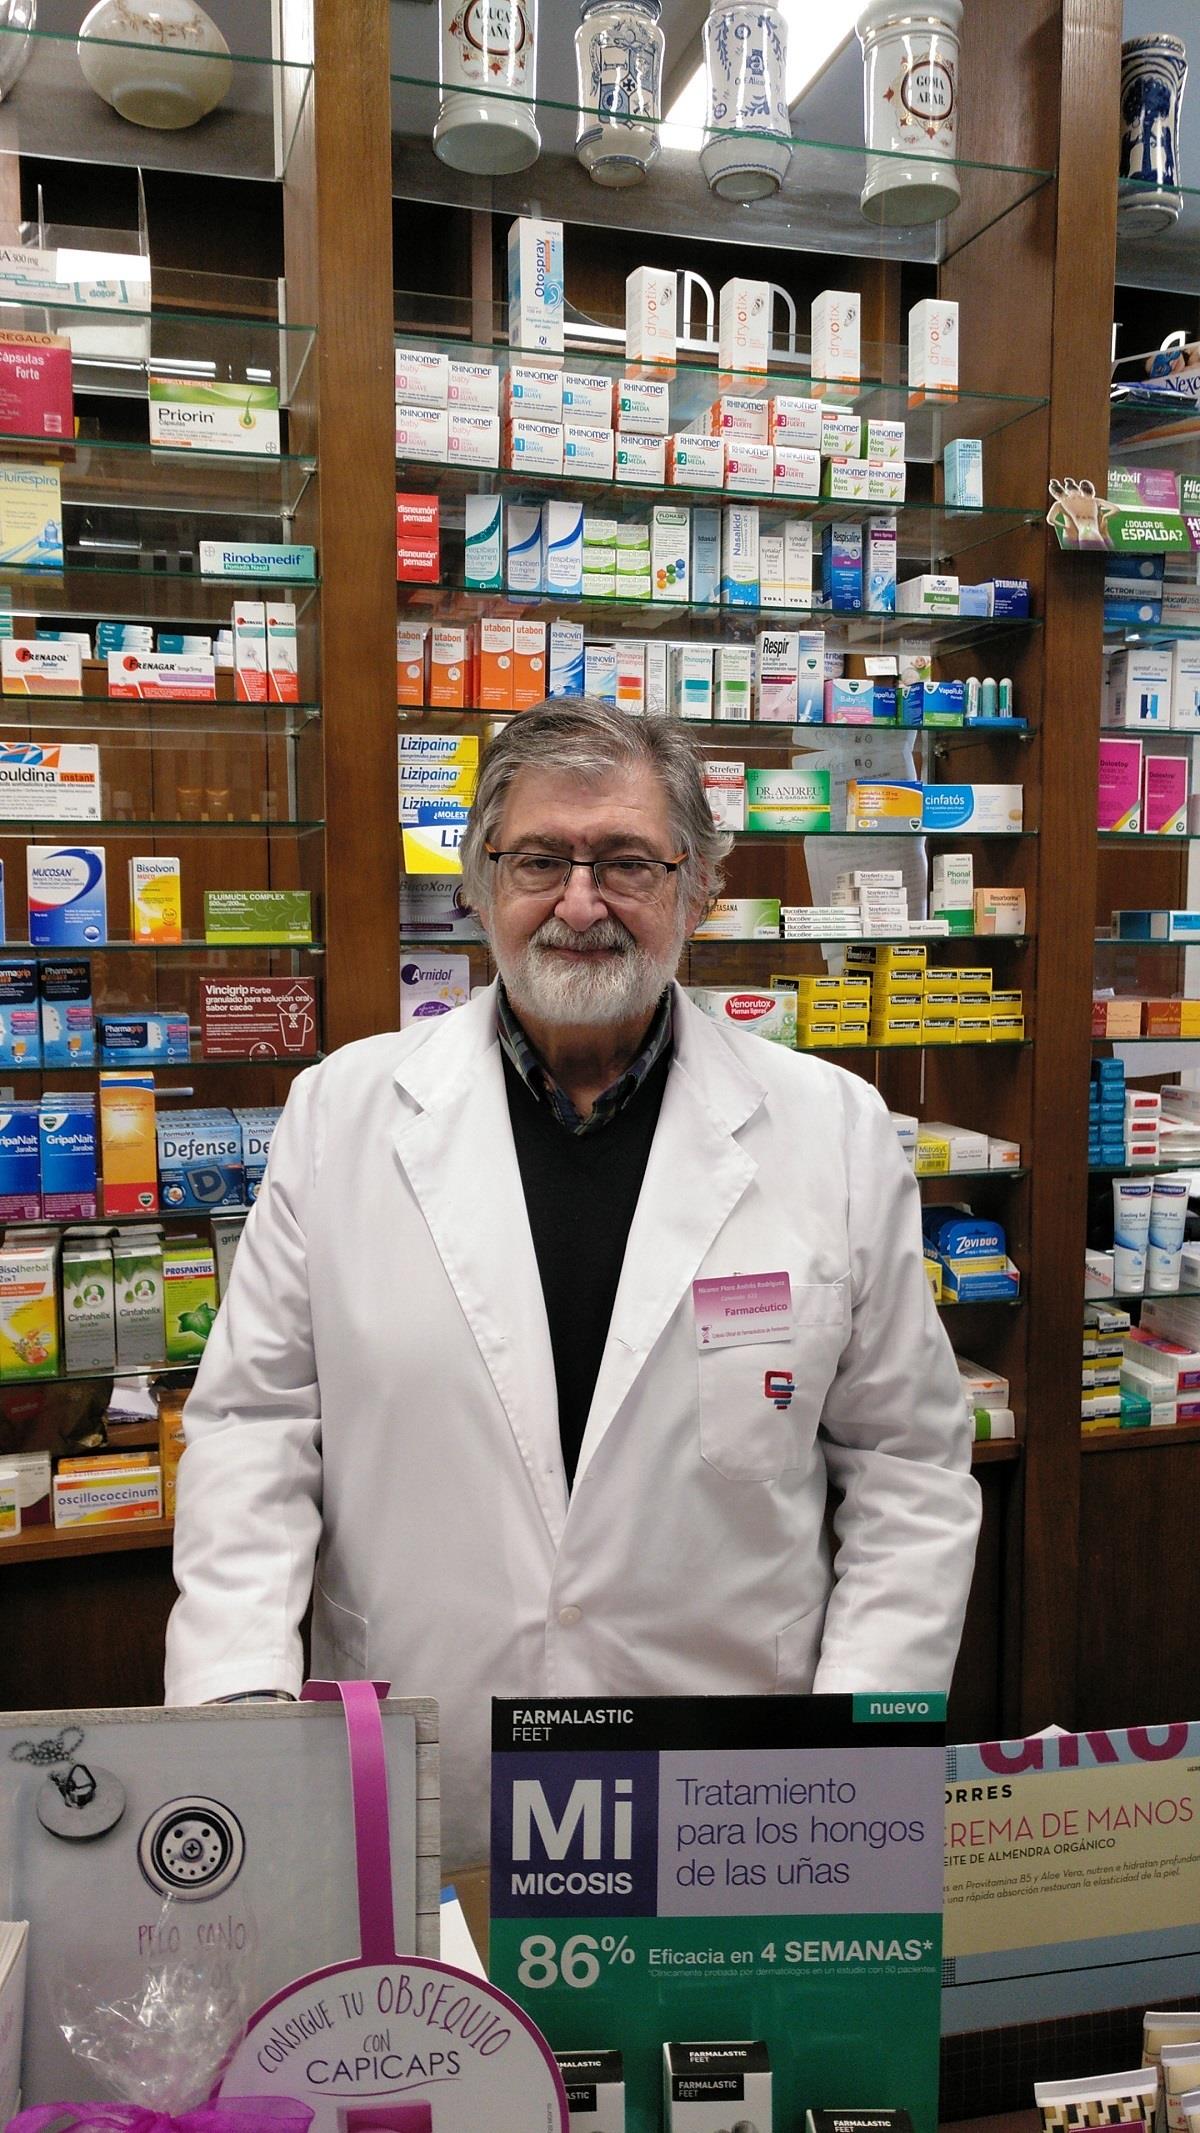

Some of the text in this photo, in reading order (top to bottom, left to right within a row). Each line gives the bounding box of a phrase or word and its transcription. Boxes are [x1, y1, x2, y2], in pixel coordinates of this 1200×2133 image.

[535, 238, 547, 298] Otospray
[16, 366, 40, 380] Forte
[158, 408, 214, 424] Priorin
[1121, 528, 1183, 541] ESPALDA?
[223, 552, 300, 566] Rinobanedif
[483, 624, 511, 633] utabon
[516, 626, 543, 635] utabon
[434, 632, 461, 642] utabon
[763, 637, 789, 657] Respir
[400, 737, 457, 752] Lizipaina
[400, 766, 458, 781] Lizipaina
[709, 766, 739, 774] Strefen
[60, 772, 95, 783] instant
[775, 787, 820, 796] ANDREU
[925, 793, 965, 805] cinfatós
[32, 868, 72, 877] MUCOSAN
[136, 864, 175, 873] Bisolvon
[249, 893, 285, 901] COMPLEX
[412, 967, 453, 981] Arnidol
[205, 985, 249, 997] Vincigrip
[205, 996, 242, 1005] granulado
[262, 995, 293, 1003] solución
[205, 1003, 228, 1011] sabor
[729, 998, 772, 1009] Venorutox
[46, 1135, 93, 1146] GripaNait
[163, 1139, 236, 1160] Defense
[165, 1265, 212, 1275] PROSPANTUS
[725, 1303, 788, 1316] Farmacéutico
[58, 1487, 158, 1506] oscillococcinum
[870, 1702, 929, 1715] nuevo
[512, 1709, 634, 1725] FARMALASTIC
[512, 1726, 552, 1742] FEET
[676, 1777, 856, 1806] Tratamiento
[511, 1779, 634, 1861] Mi
[944, 1797, 1194, 1849] REMA DE MANOS
[676, 1815, 925, 1851] para los hongos
[969, 1852, 985, 1864] DE
[988, 1846, 1051, 1862] ALMENDRA
[1053, 1837, 1116, 1855] ORGÁNICO
[676, 1858, 850, 1886] de las uñas
[952, 1883, 964, 1891] en
[966, 1875, 1018, 1890] Provitamina
[1063, 1868, 1084, 1878] Vera,
[1086, 1866, 1113, 1876] nutren
[1123, 1859, 1158, 1871] hidratan
[511, 1872, 633, 1895] MICOSIS
[966, 1890, 995, 1903] rápida
[997, 1885, 1039, 1898] absorción
[1041, 1881, 1081, 1893] restauran
[1083, 1879, 1091, 1888] la
[1093, 1873, 1139, 1887] elasticidad
[1141, 1871, 1151, 1880] de
[1153, 1869, 1162, 1878] la
[648, 1948, 725, 1964] Eficacia
[730, 1949, 753, 1963] en
[761, 1943, 776, 1962] 4
[517, 1934, 635, 1989] 86%
[257, 1974, 511, 2074] CONSIGUE TU OBSEQUIO
[363, 2029, 390, 2053] CON
[306, 2051, 460, 2084] CAPICAPS
[678, 2080, 737, 2090] FARMALASTIC
[678, 2089, 698, 2098] FEET
